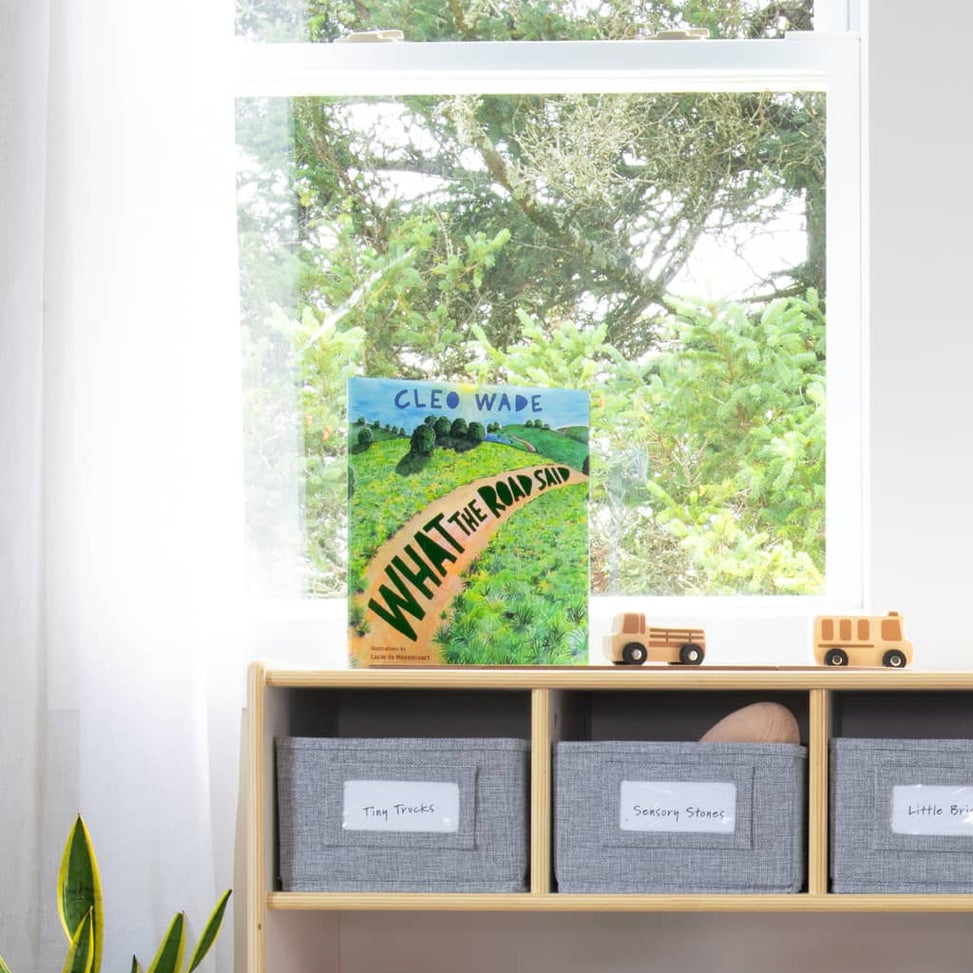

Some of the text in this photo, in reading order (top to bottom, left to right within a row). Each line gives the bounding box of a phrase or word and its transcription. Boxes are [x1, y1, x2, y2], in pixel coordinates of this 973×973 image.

[394, 389, 543, 413] CLEO WADE
[368, 466, 570, 642] WHAT THE ROAD SAID
[362, 803, 434, 821] Tiny Trucks
[633, 805, 725, 822] Sensory Stones
[908, 805, 944, 815] Little
